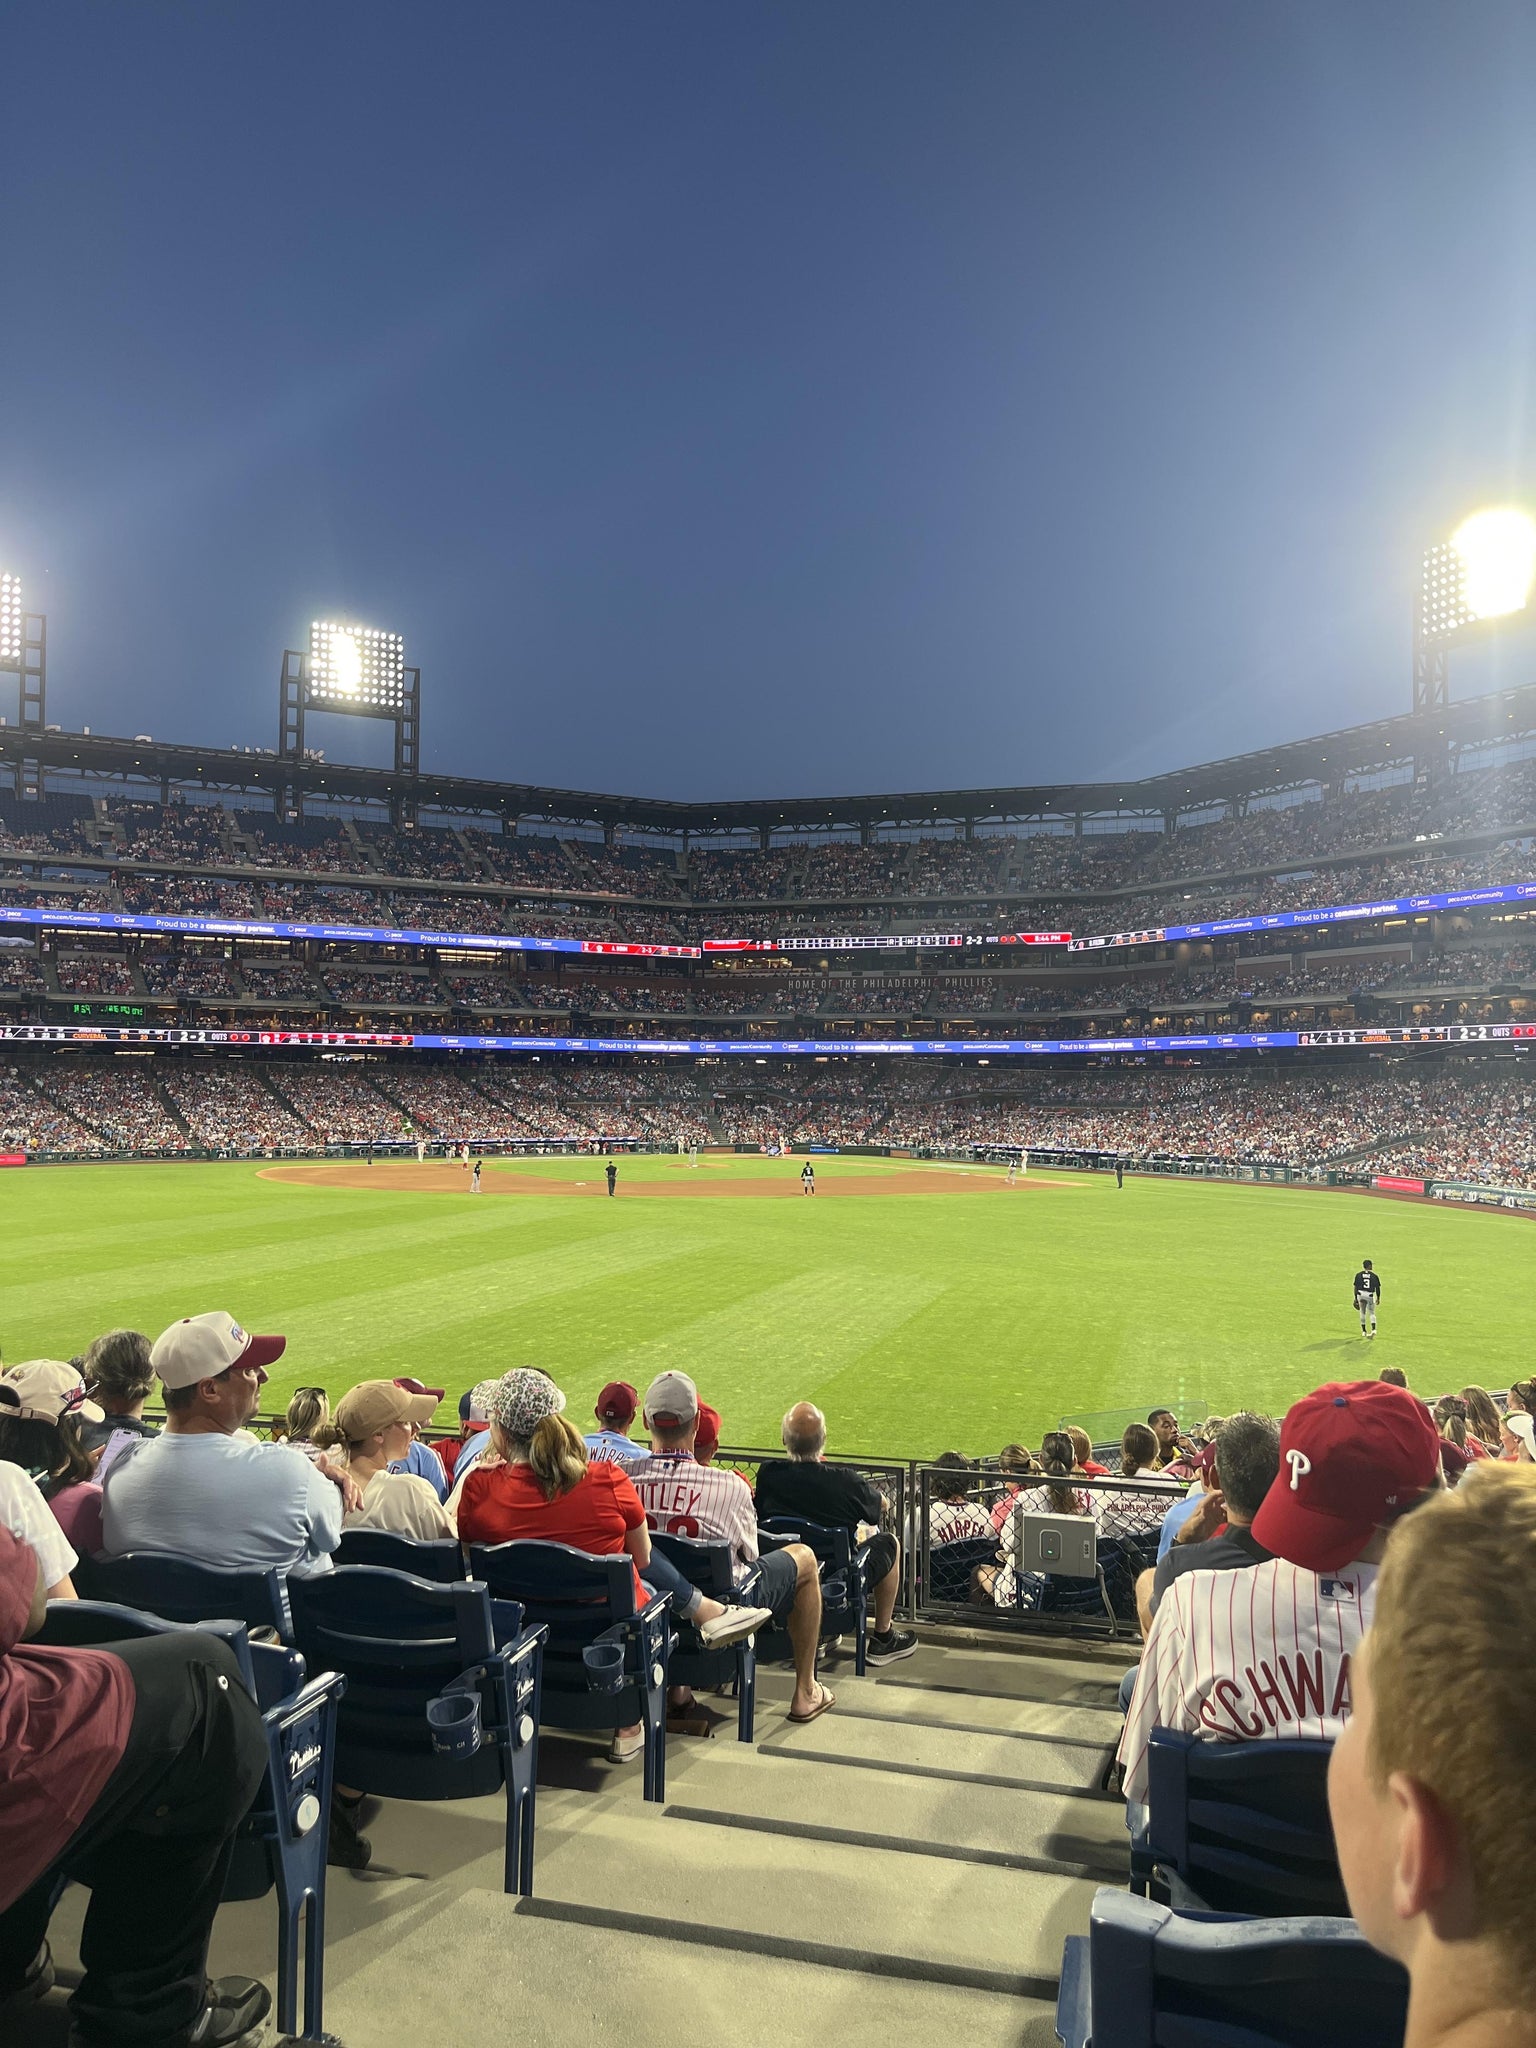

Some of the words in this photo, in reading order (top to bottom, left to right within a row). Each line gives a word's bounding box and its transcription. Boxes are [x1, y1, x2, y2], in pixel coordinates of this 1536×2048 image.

[1447, 890, 1504, 904] peco.com/Community
[42, 913, 101, 923] peco.com/Community
[1293, 914, 1312, 922] Proud
[1334, 906, 1371, 917] community
[1371, 904, 1398, 914] partner.
[156, 919, 178, 928] Proud
[189, 921, 199, 929] be
[206, 923, 246, 933] community
[247, 924, 275, 933] partner.
[323, 930, 373, 938] peco.com/Community
[1050, 934, 1061, 942] PM
[420, 934, 440, 942] Proud
[448, 935, 457, 943] be
[462, 937, 498, 947] community
[966, 935, 983, 945] 2-2
[788, 980, 816, 989] HOME
[821, 979, 832, 989] OF
[840, 979, 857, 988] THE
[945, 977, 993, 987] PHILLIES
[1492, 1028, 1510, 1037] OUTS
[1089, 1041, 1114, 1049] community
[1363, 1279, 1370, 1288] 3
[1285, 1448, 1312, 1491] P
[937, 1519, 985, 1544] HARPER
